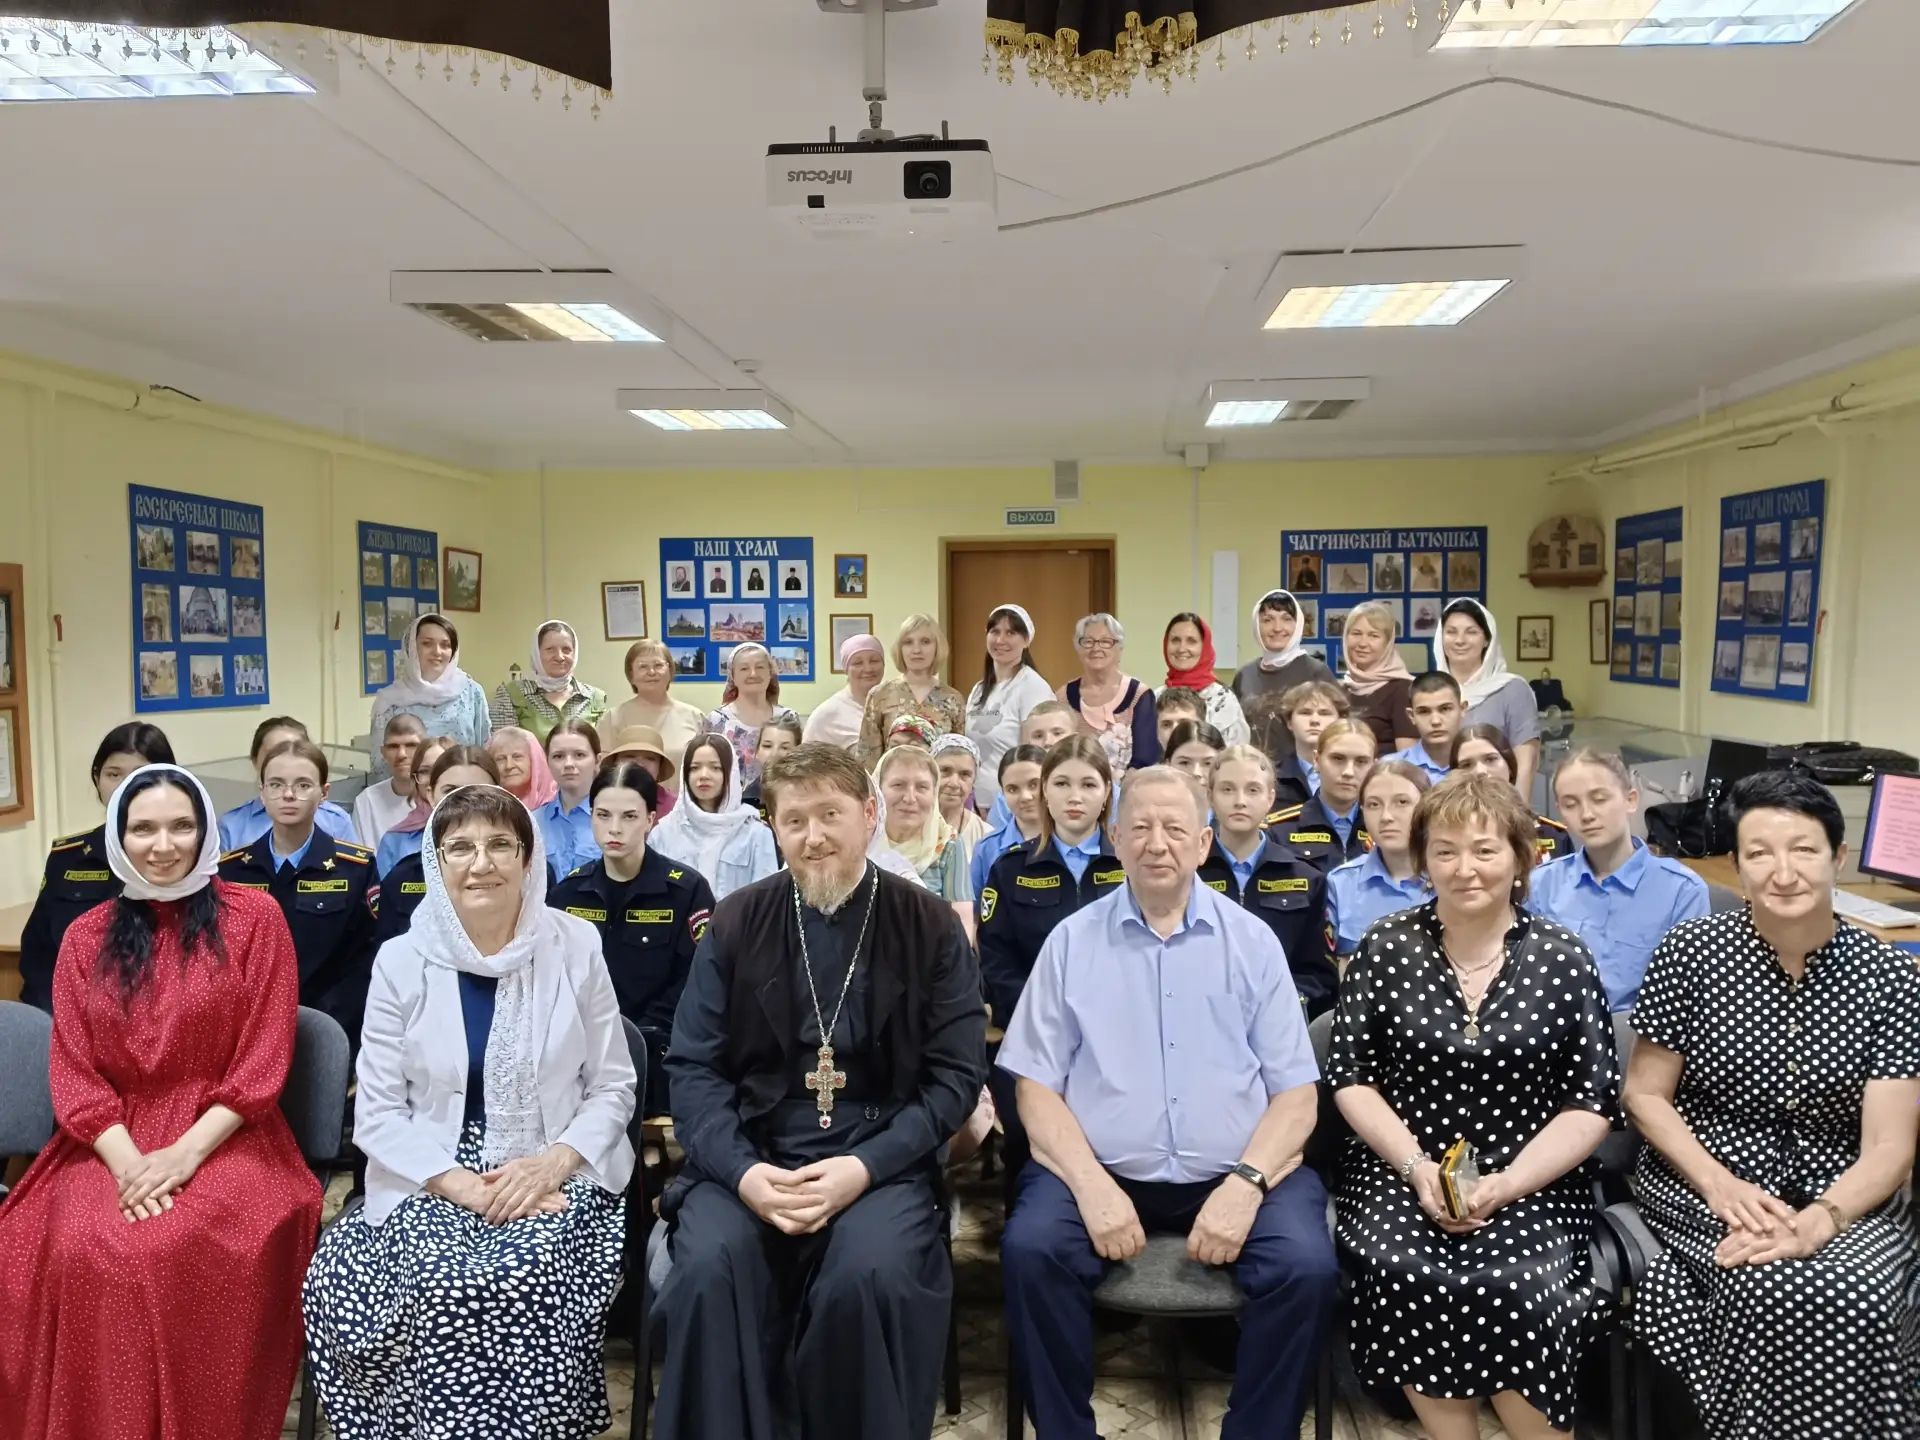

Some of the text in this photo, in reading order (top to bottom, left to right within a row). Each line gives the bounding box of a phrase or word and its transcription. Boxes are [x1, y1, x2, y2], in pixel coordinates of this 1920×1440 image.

[787, 169, 853, 185] InFocus
[135, 493, 260, 534] ВОСКРЕСНАЯ ШКОЛА
[1009, 512, 1054, 522] ВЫХОД
[694, 540, 779, 556] НАШ ХРАМ
[1288, 530, 1480, 550] ЧАГРИНСКИЙ БАТЮШКА
